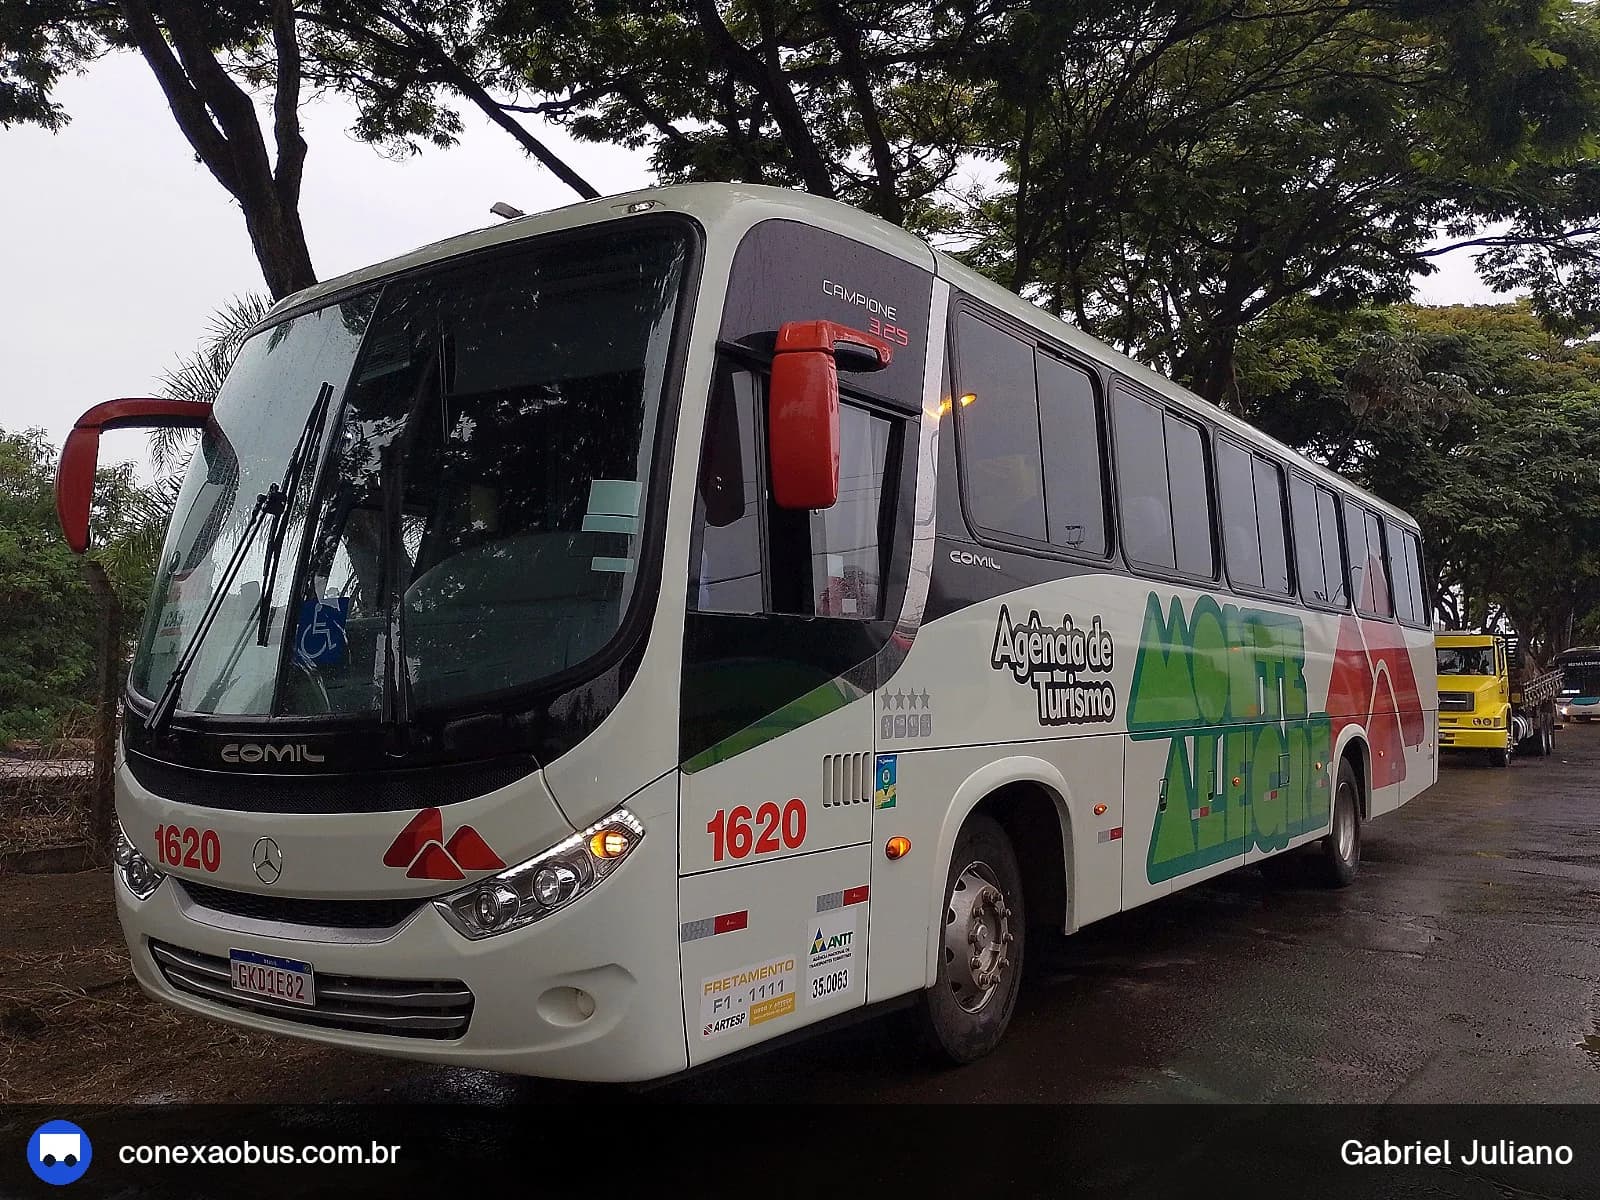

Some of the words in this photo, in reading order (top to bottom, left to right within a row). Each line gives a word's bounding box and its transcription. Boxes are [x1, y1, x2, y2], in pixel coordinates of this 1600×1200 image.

[823, 279, 897, 322] CAMPIONE
[868, 317, 909, 346] 3.25
[950, 550, 1002, 570] COMIL
[992, 606, 1086, 681] Agência
[1087, 616, 1113, 671] de
[1128, 592, 1308, 738] MONTE
[1032, 672, 1115, 723] Turismo
[220, 743, 325, 763] COMIL
[1147, 716, 1331, 884] ALEGRE
[154, 823, 222, 873] 1620
[706, 797, 808, 863] 1620
[827, 931, 854, 951] ANTT
[238, 963, 305, 1001] GKD1E82
[704, 959, 794, 997] FRETAMENTO
[713, 995, 731, 1014] F1
[749, 979, 784, 1002] 1111
[812, 968, 849, 999] 35.0063
[713, 1012, 746, 1033] ARTESP
